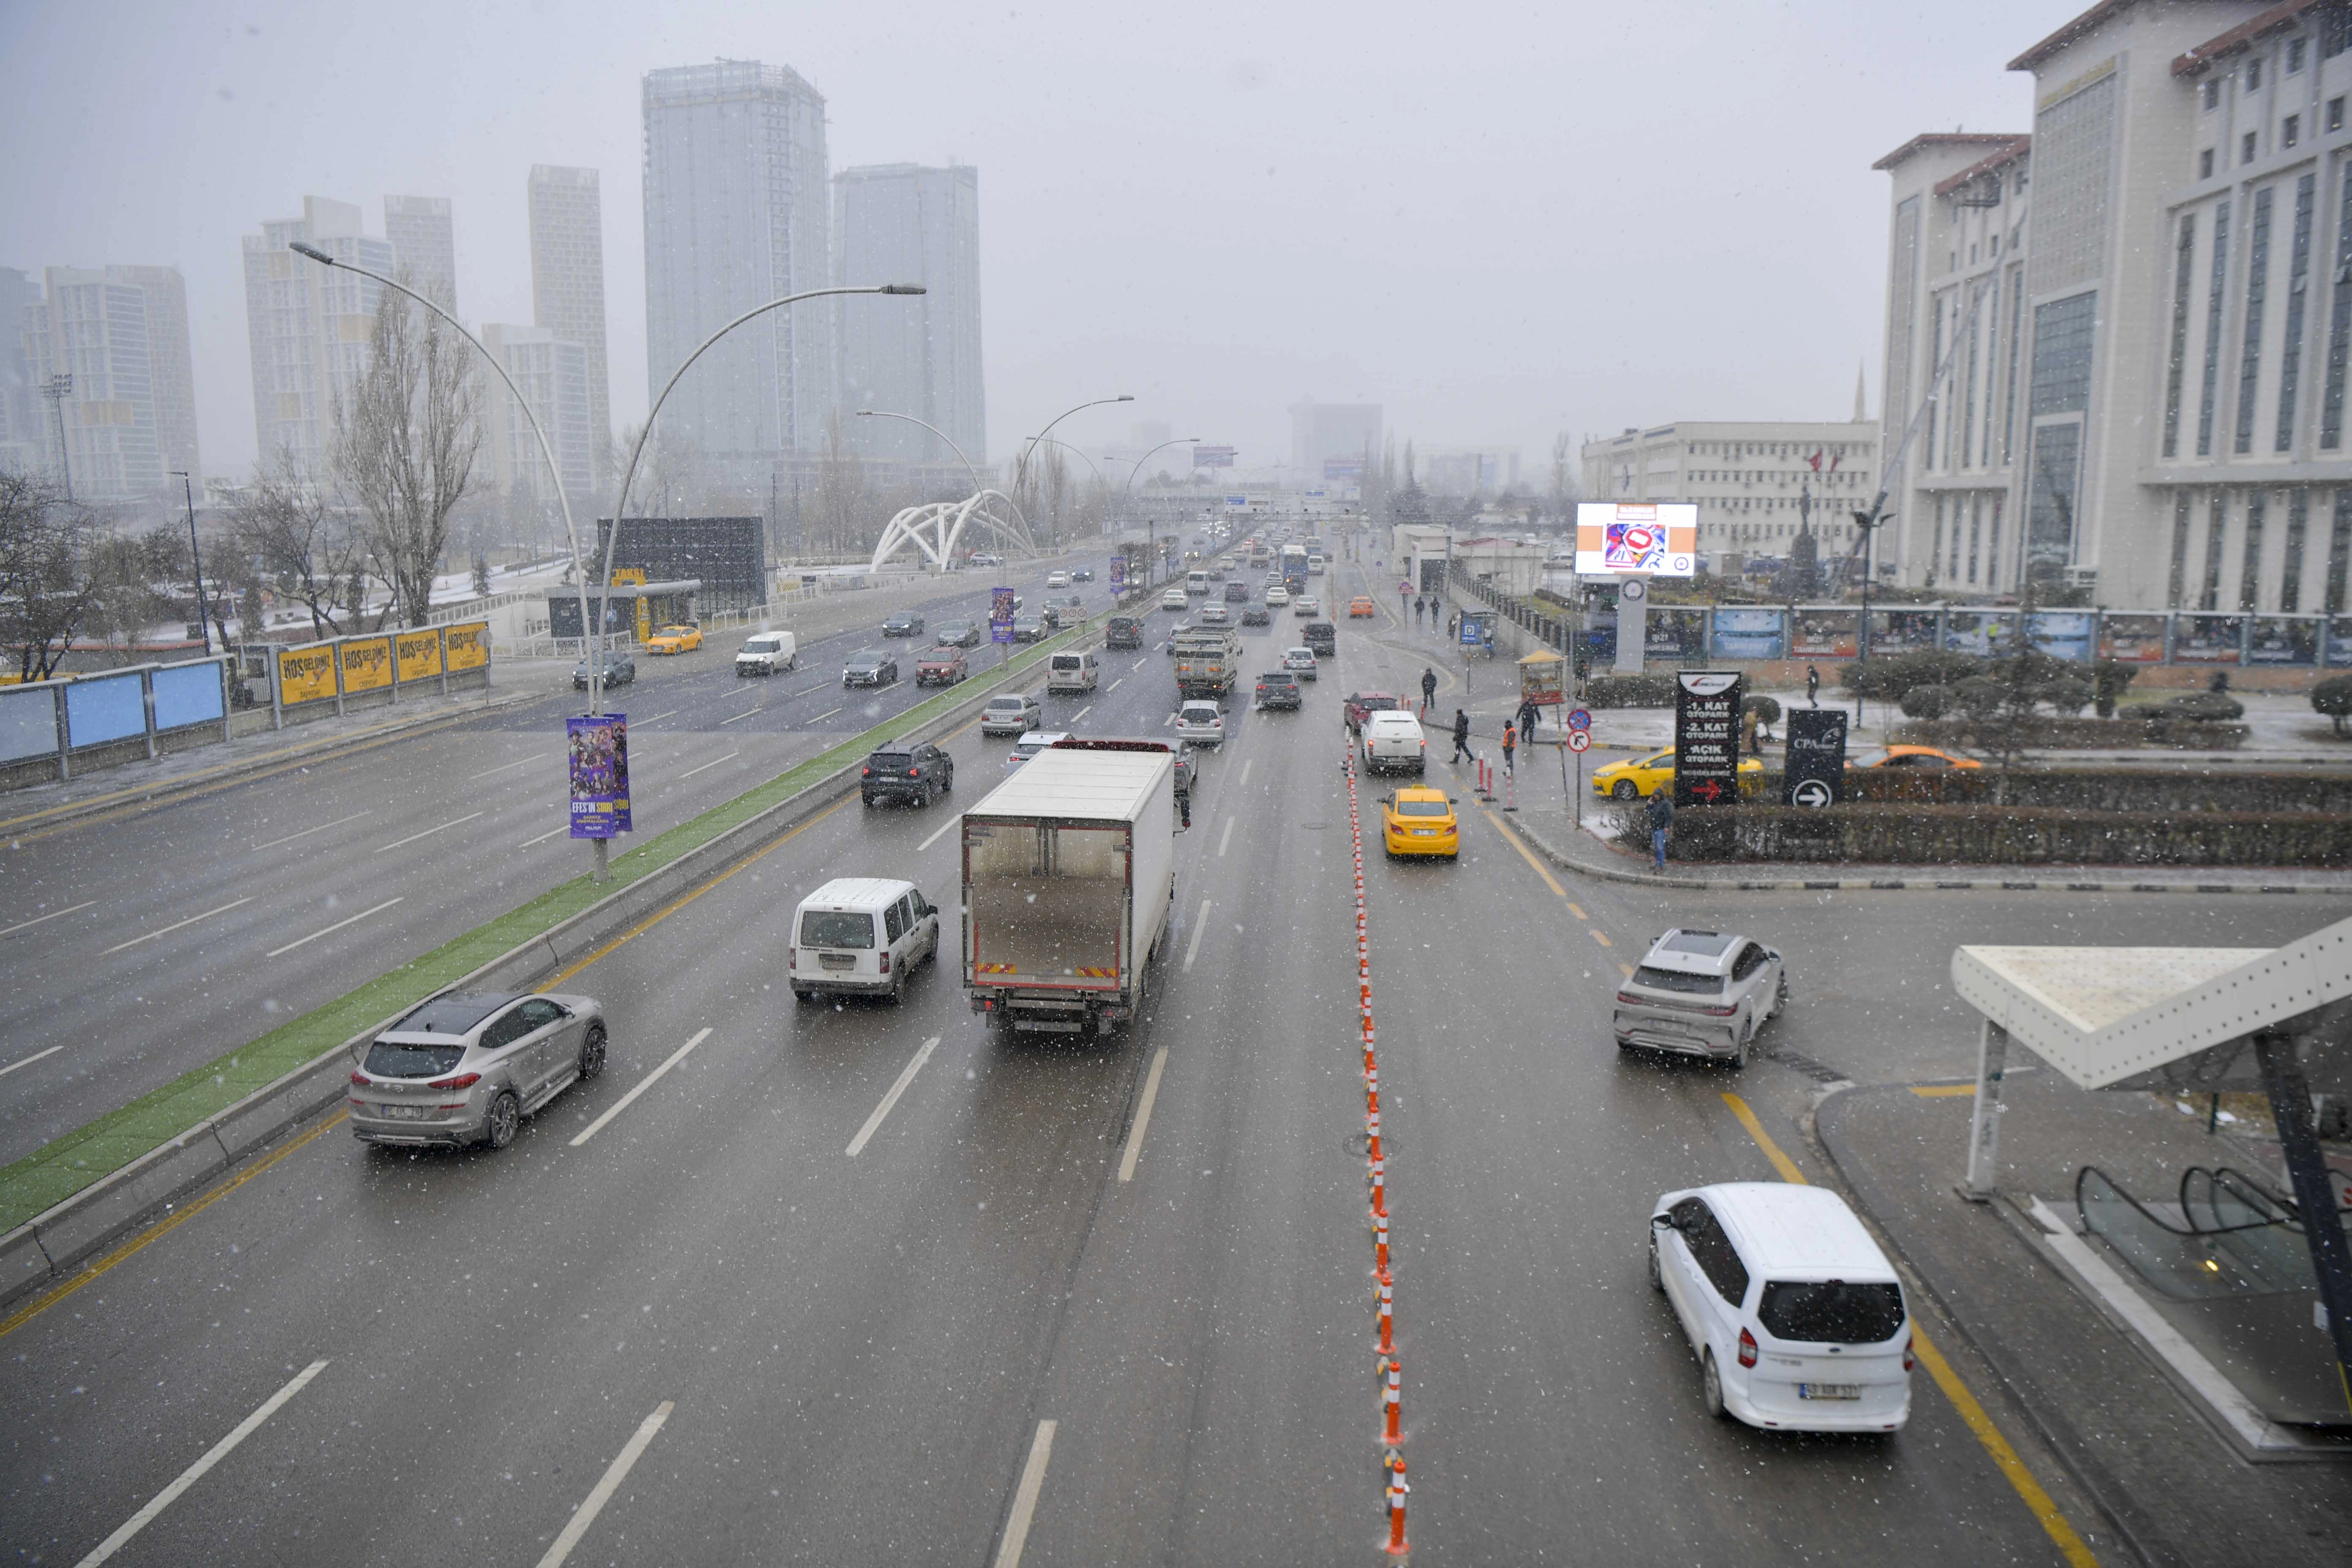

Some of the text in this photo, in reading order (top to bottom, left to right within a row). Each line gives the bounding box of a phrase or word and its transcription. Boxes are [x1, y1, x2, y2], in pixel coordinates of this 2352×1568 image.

[1704, 702, 1730, 710] KAT
[1686, 723, 1729, 731] -2. KAT
[1690, 745, 1722, 755] AÇIK
[596, 802, 613, 813] SIRRI
